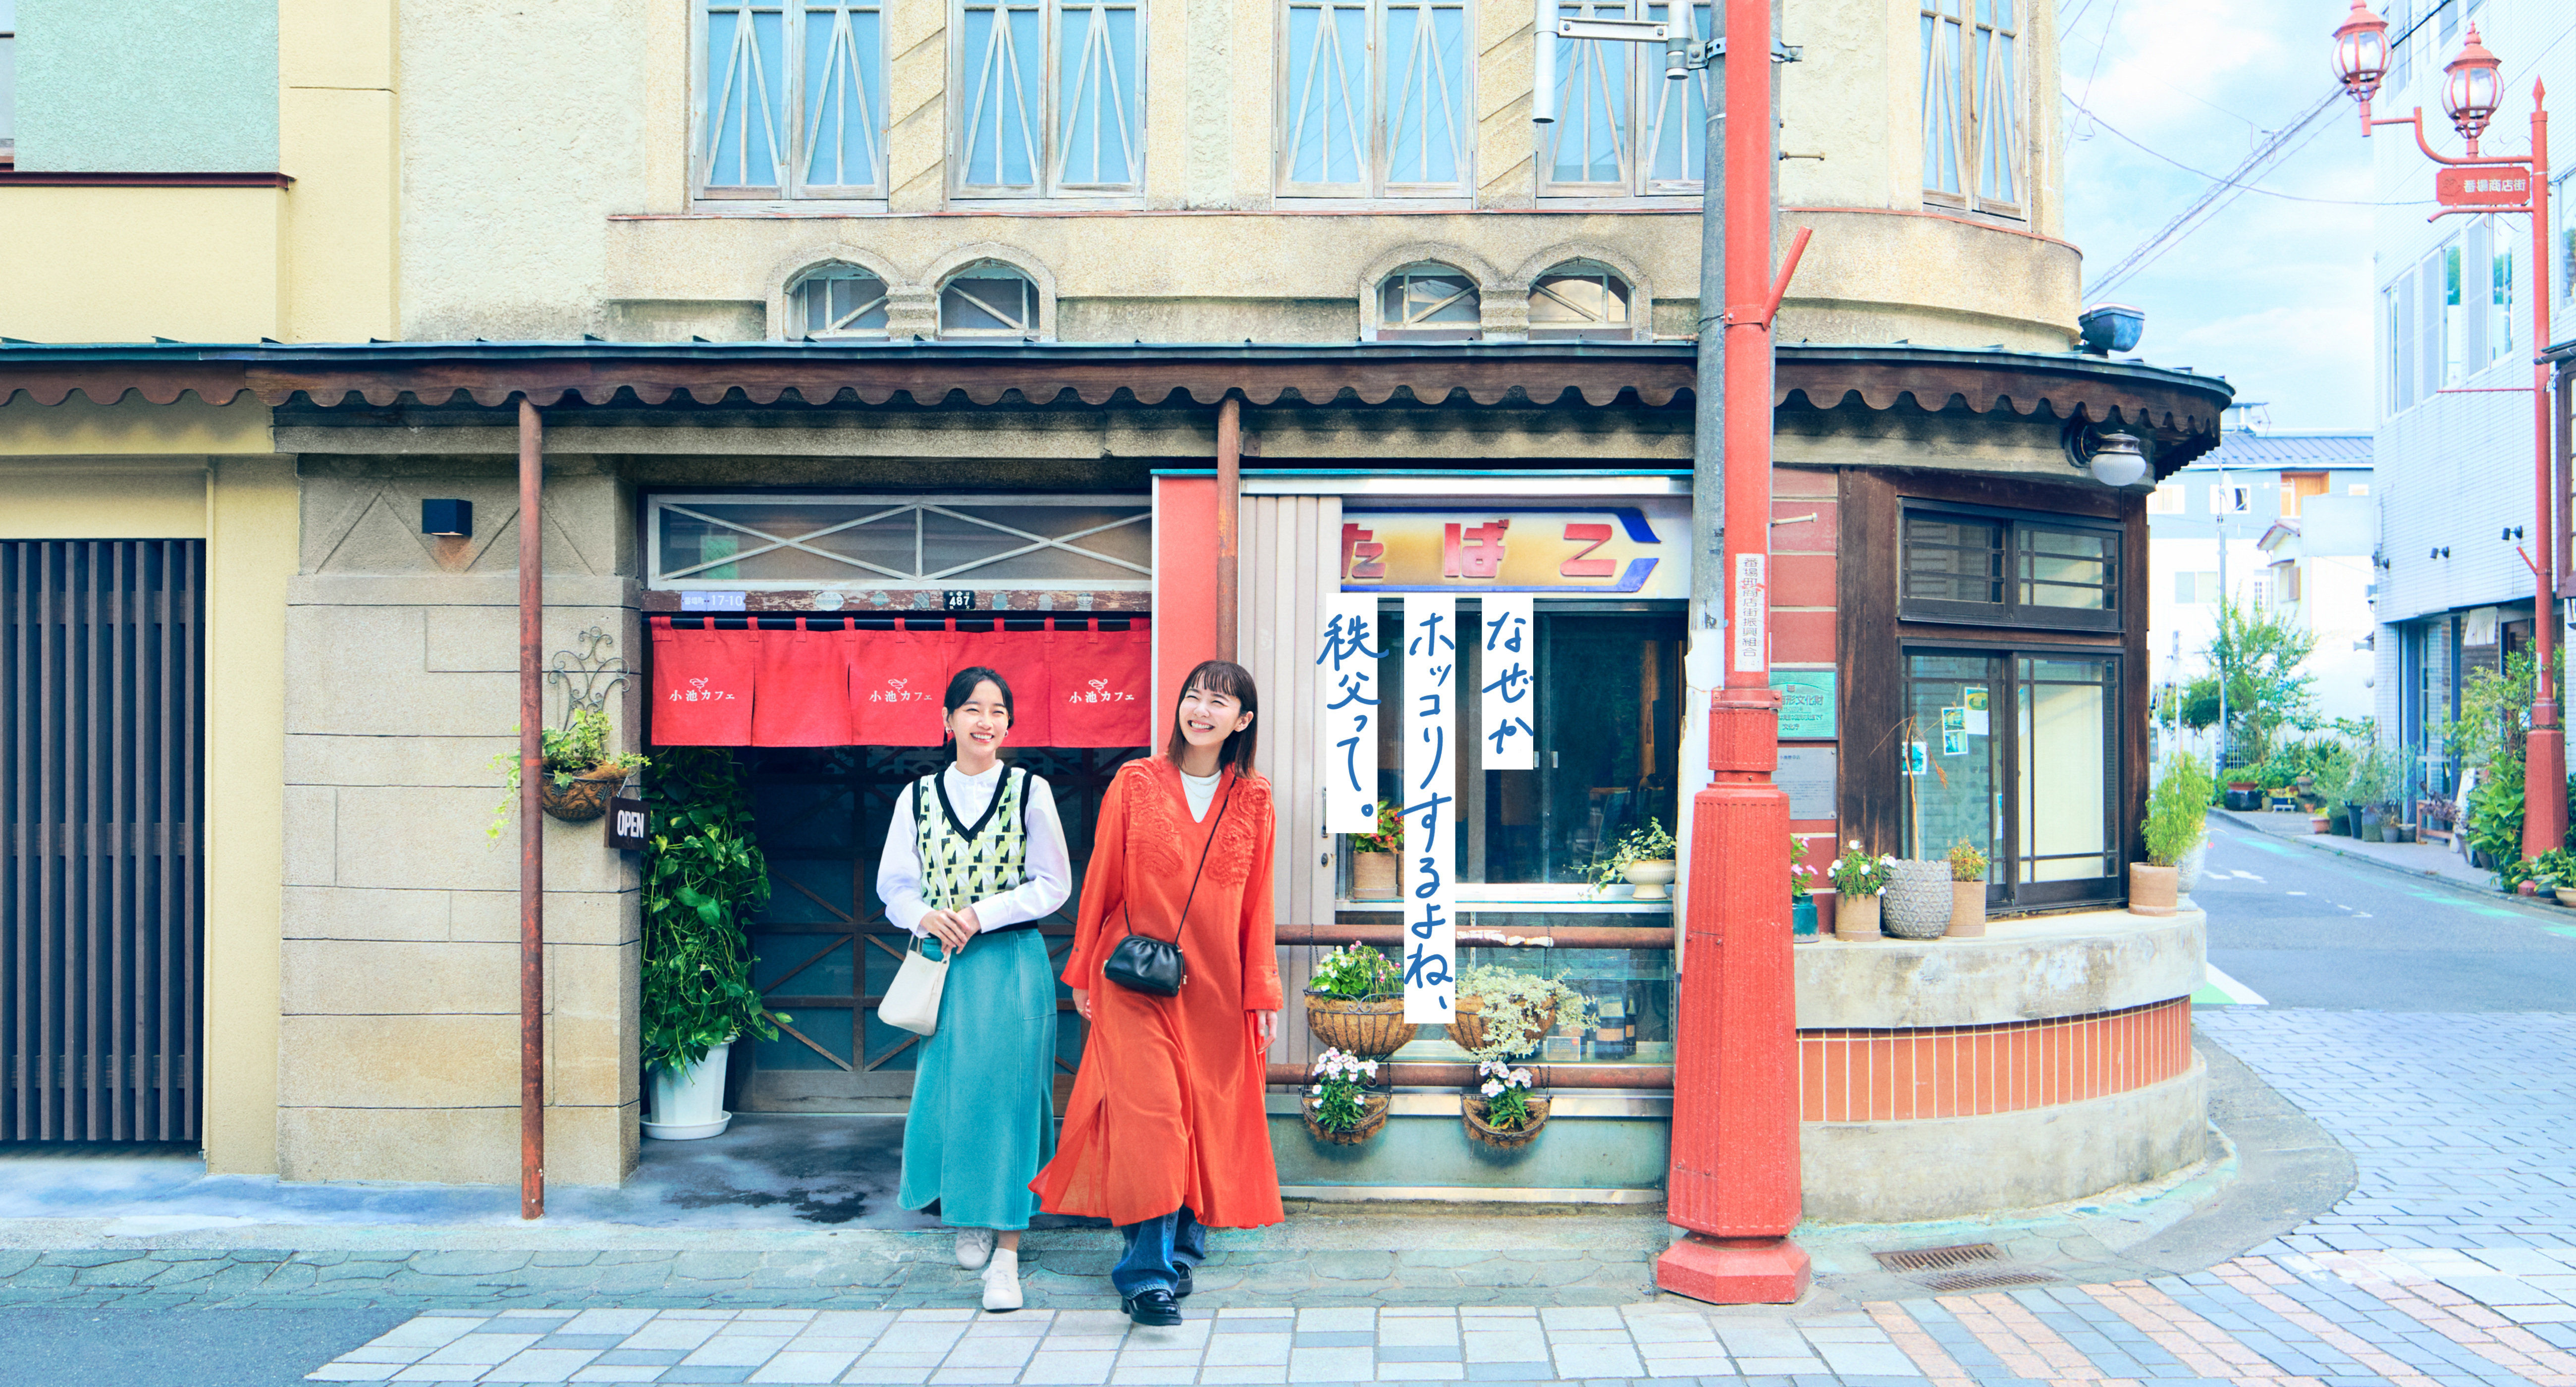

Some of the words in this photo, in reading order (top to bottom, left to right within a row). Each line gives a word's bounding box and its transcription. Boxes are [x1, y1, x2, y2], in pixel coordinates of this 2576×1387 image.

[2464, 179, 2526, 193] 番場商店街
[1341, 519, 1617, 579] たばこ
[684, 596, 705, 605] 番場町
[711, 595, 743, 606] 17-10
[949, 596, 970, 606] 487
[669, 690, 735, 703] 小池カフェ
[869, 690, 933, 703] 小池カフェ
[1069, 691, 1135, 703] 小池カフェ
[617, 809, 644, 838] OPEN
